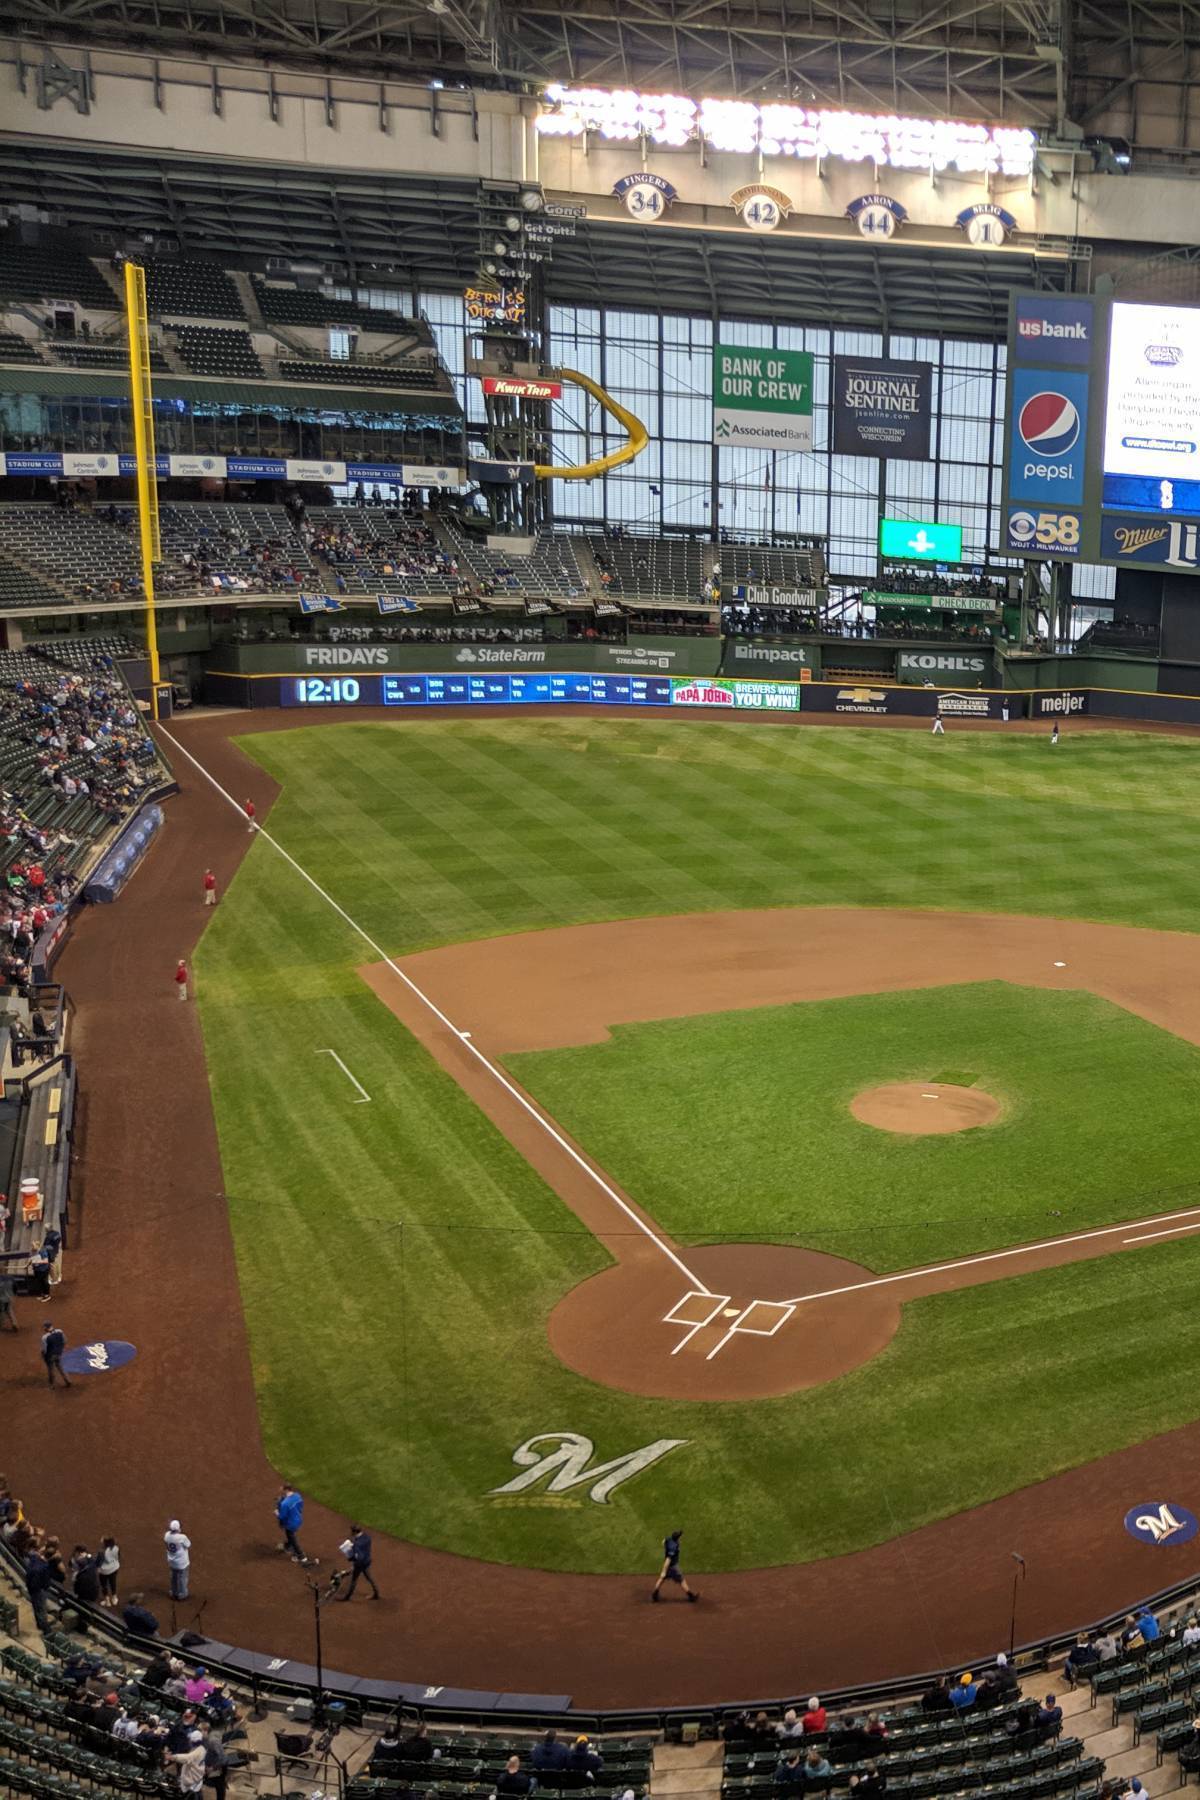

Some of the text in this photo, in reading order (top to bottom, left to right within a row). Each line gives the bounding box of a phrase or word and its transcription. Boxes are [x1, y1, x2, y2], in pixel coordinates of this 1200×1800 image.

[624, 174, 667, 190] FINGERS
[738, 184, 786, 201] ROBINSON
[544, 204, 586, 217] Gone!
[631, 191, 660, 214] 34
[862, 196, 894, 209] AARON
[972, 204, 1002, 216] SELIG
[748, 203, 776, 224] 42
[525, 224, 576, 237] Get Outta
[862, 212, 890, 234] 44
[528, 233, 553, 244] Here
[982, 223, 992, 242] 1
[510, 251, 543, 262] Get Up
[499, 269, 532, 281] Get Up
[722, 357, 786, 379] BANK OF
[722, 378, 752, 397] OUR
[846, 379, 920, 398] JOURNAL
[845, 394, 919, 413] SENTINEL
[855, 410, 911, 421] jsonline.com
[857, 425, 905, 436] CONNECTING
[861, 433, 902, 443] WISCONSIN
[229, 464, 285, 473] STADIUM CLUB
[1024, 463, 1075, 481] pepsi
[1035, 513, 1080, 545] 58
[1011, 540, 1078, 553] WDJT MILWAUKEE
[1114, 527, 1169, 554] Miller
[747, 587, 817, 606] Club Goodwill
[939, 597, 991, 609] CHECK DECK
[306, 648, 389, 665] FRIDAYS
[749, 645, 805, 662] impact
[616, 658, 648, 666] STREAMING
[901, 654, 984, 671] KOHL'S
[297, 679, 360, 702] 12:10
[676, 690, 700, 703] PAPA
[736, 683, 797, 695] BREWERS WIN!
[736, 694, 796, 708] YOU WIN!
[1042, 692, 1085, 714] meijer
